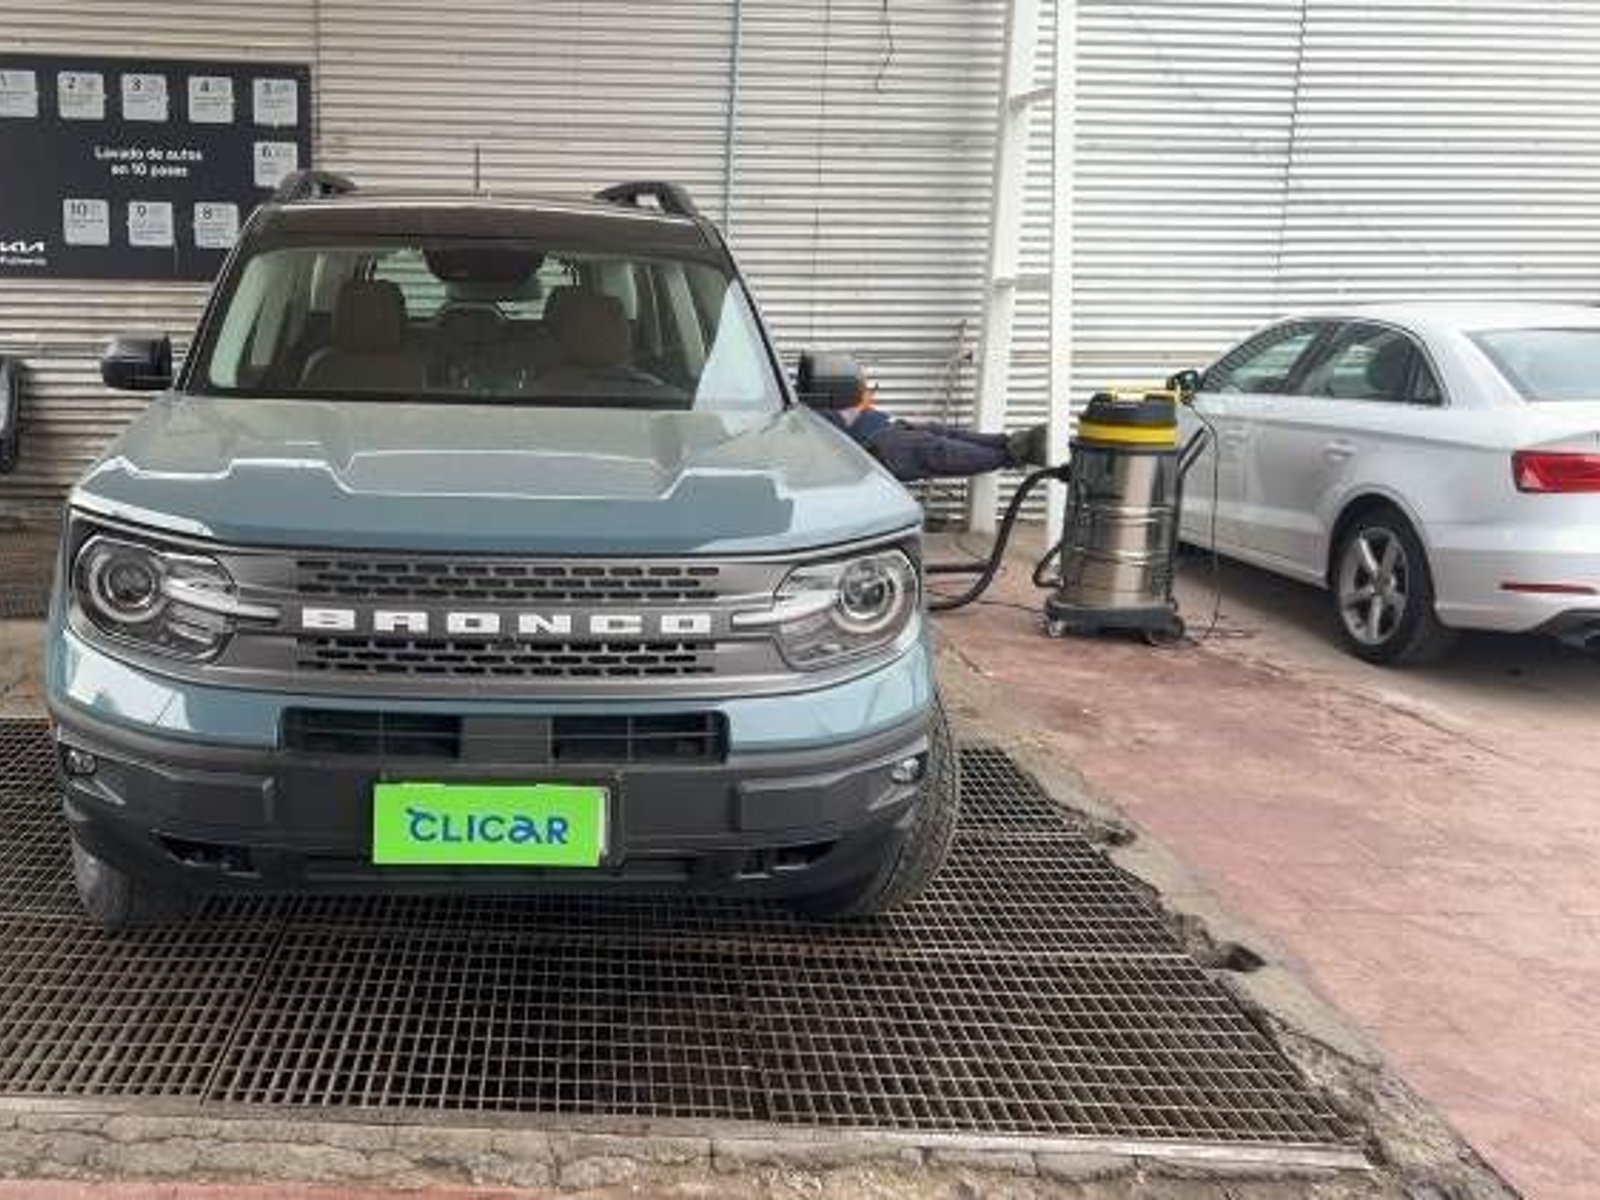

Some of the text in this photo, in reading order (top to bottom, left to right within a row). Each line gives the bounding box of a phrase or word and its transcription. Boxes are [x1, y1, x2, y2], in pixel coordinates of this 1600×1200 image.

[65, 75, 77, 90] 2
[131, 77, 141, 91] 3
[145, 147, 163, 160] de
[111, 164, 130, 176] en
[71, 201, 87, 217] 10
[137, 203, 147, 218] 9
[203, 205, 213, 220] 8
[301, 607, 712, 634] BRONCO
